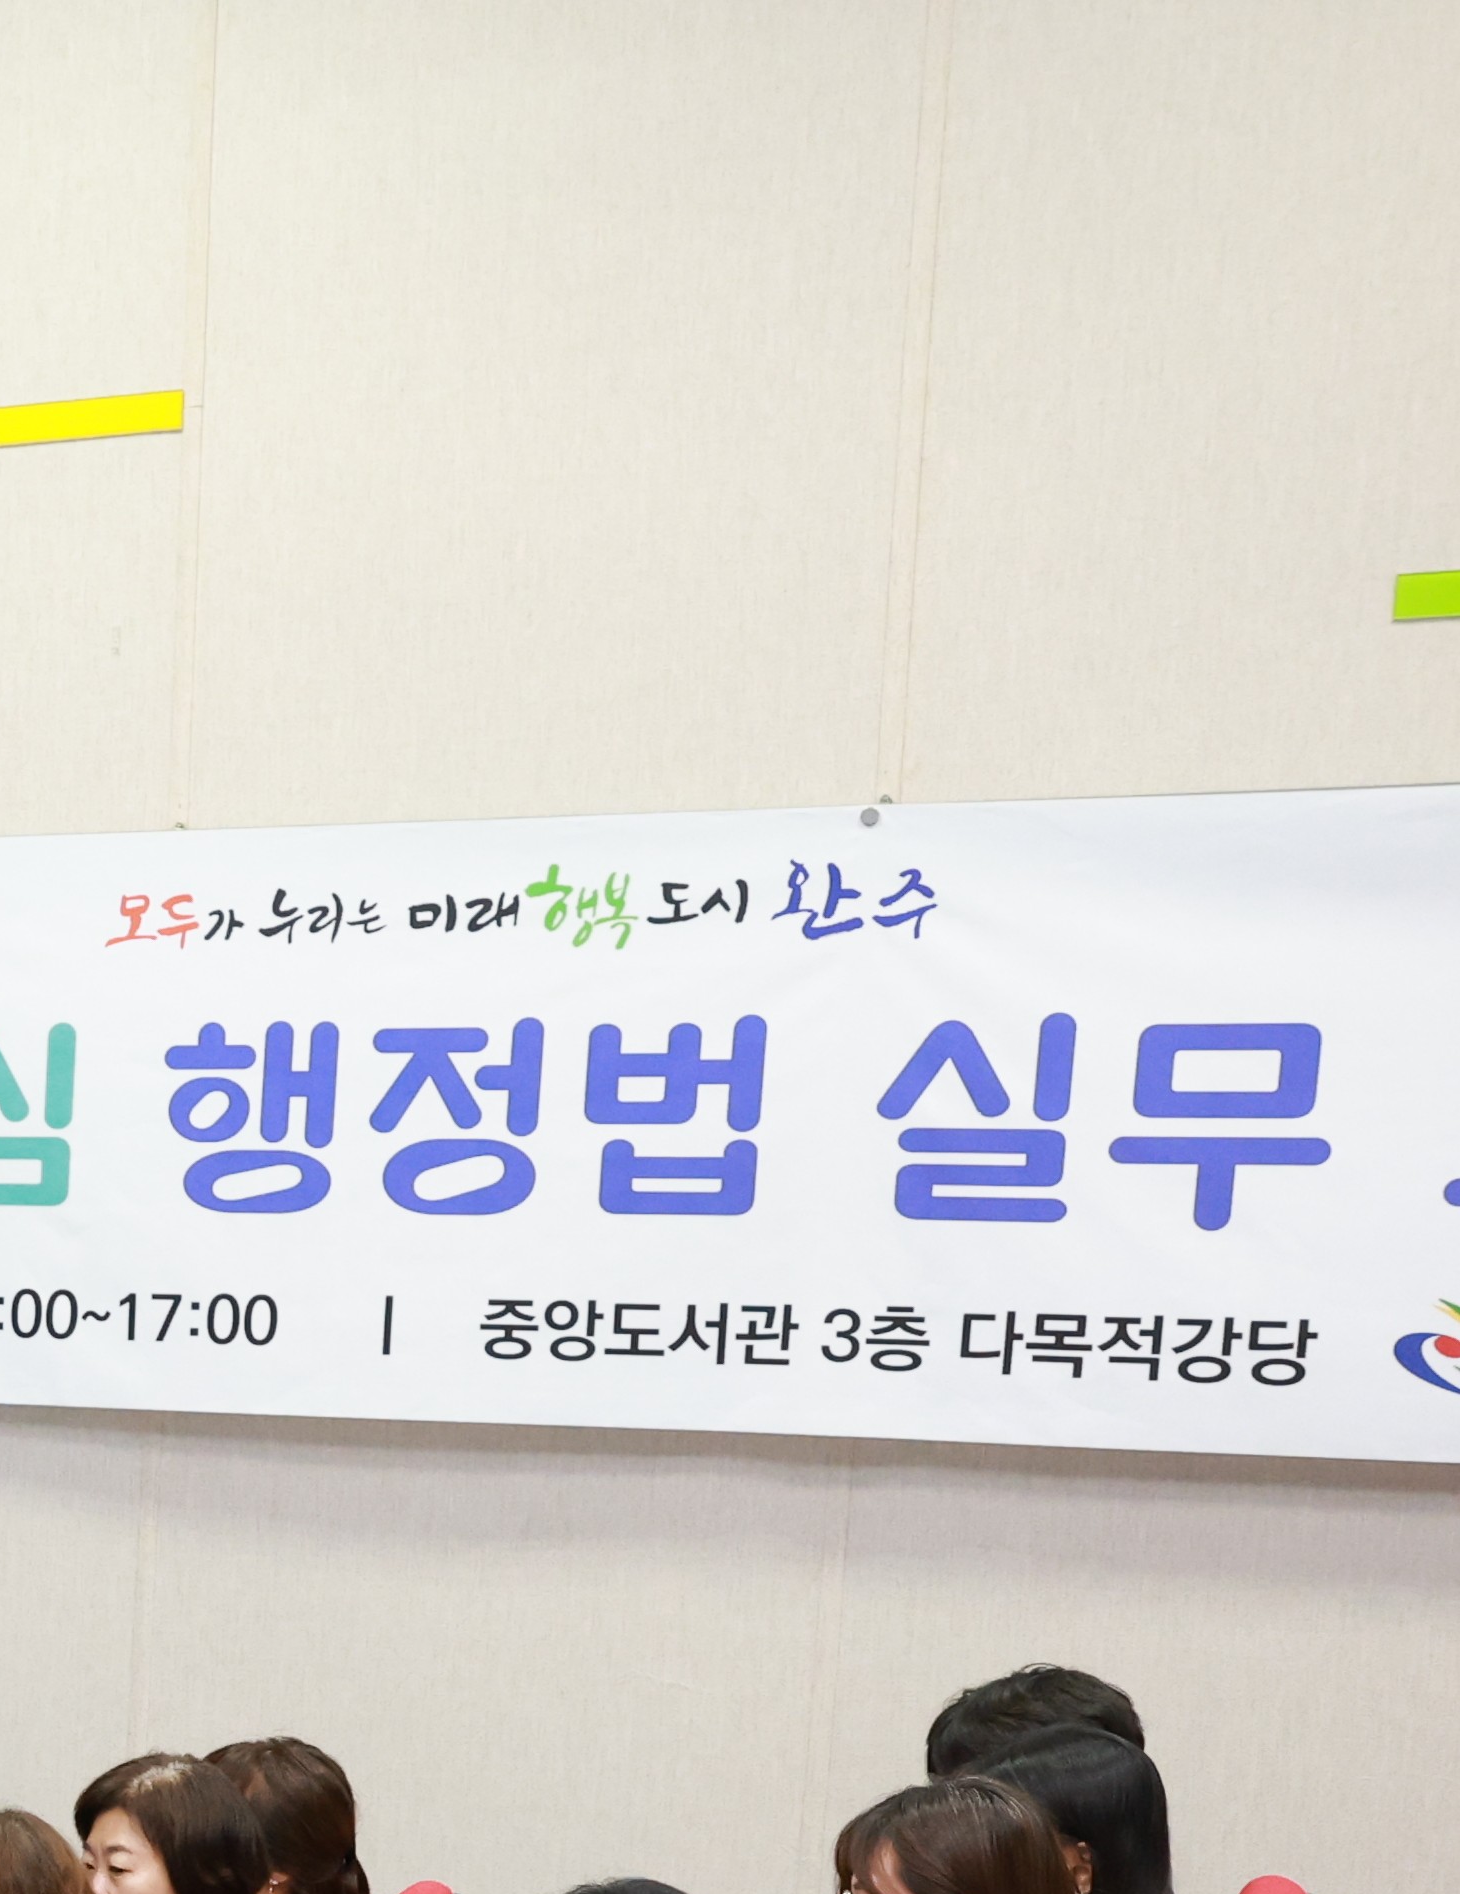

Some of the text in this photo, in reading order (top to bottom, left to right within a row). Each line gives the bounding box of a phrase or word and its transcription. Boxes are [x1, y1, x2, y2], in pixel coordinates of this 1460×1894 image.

[106, 892, 245, 949] 모두가
[257, 886, 387, 945] 누리는
[771, 859, 939, 941] 완주
[164, 1014, 768, 1217] 행정법
[876, 1012, 1332, 1232] 실무
[479, 1298, 800, 1367] 중앙도서관
[820, 1305, 931, 1373] 3층
[959, 1310, 1319, 1387] 다목적강당
